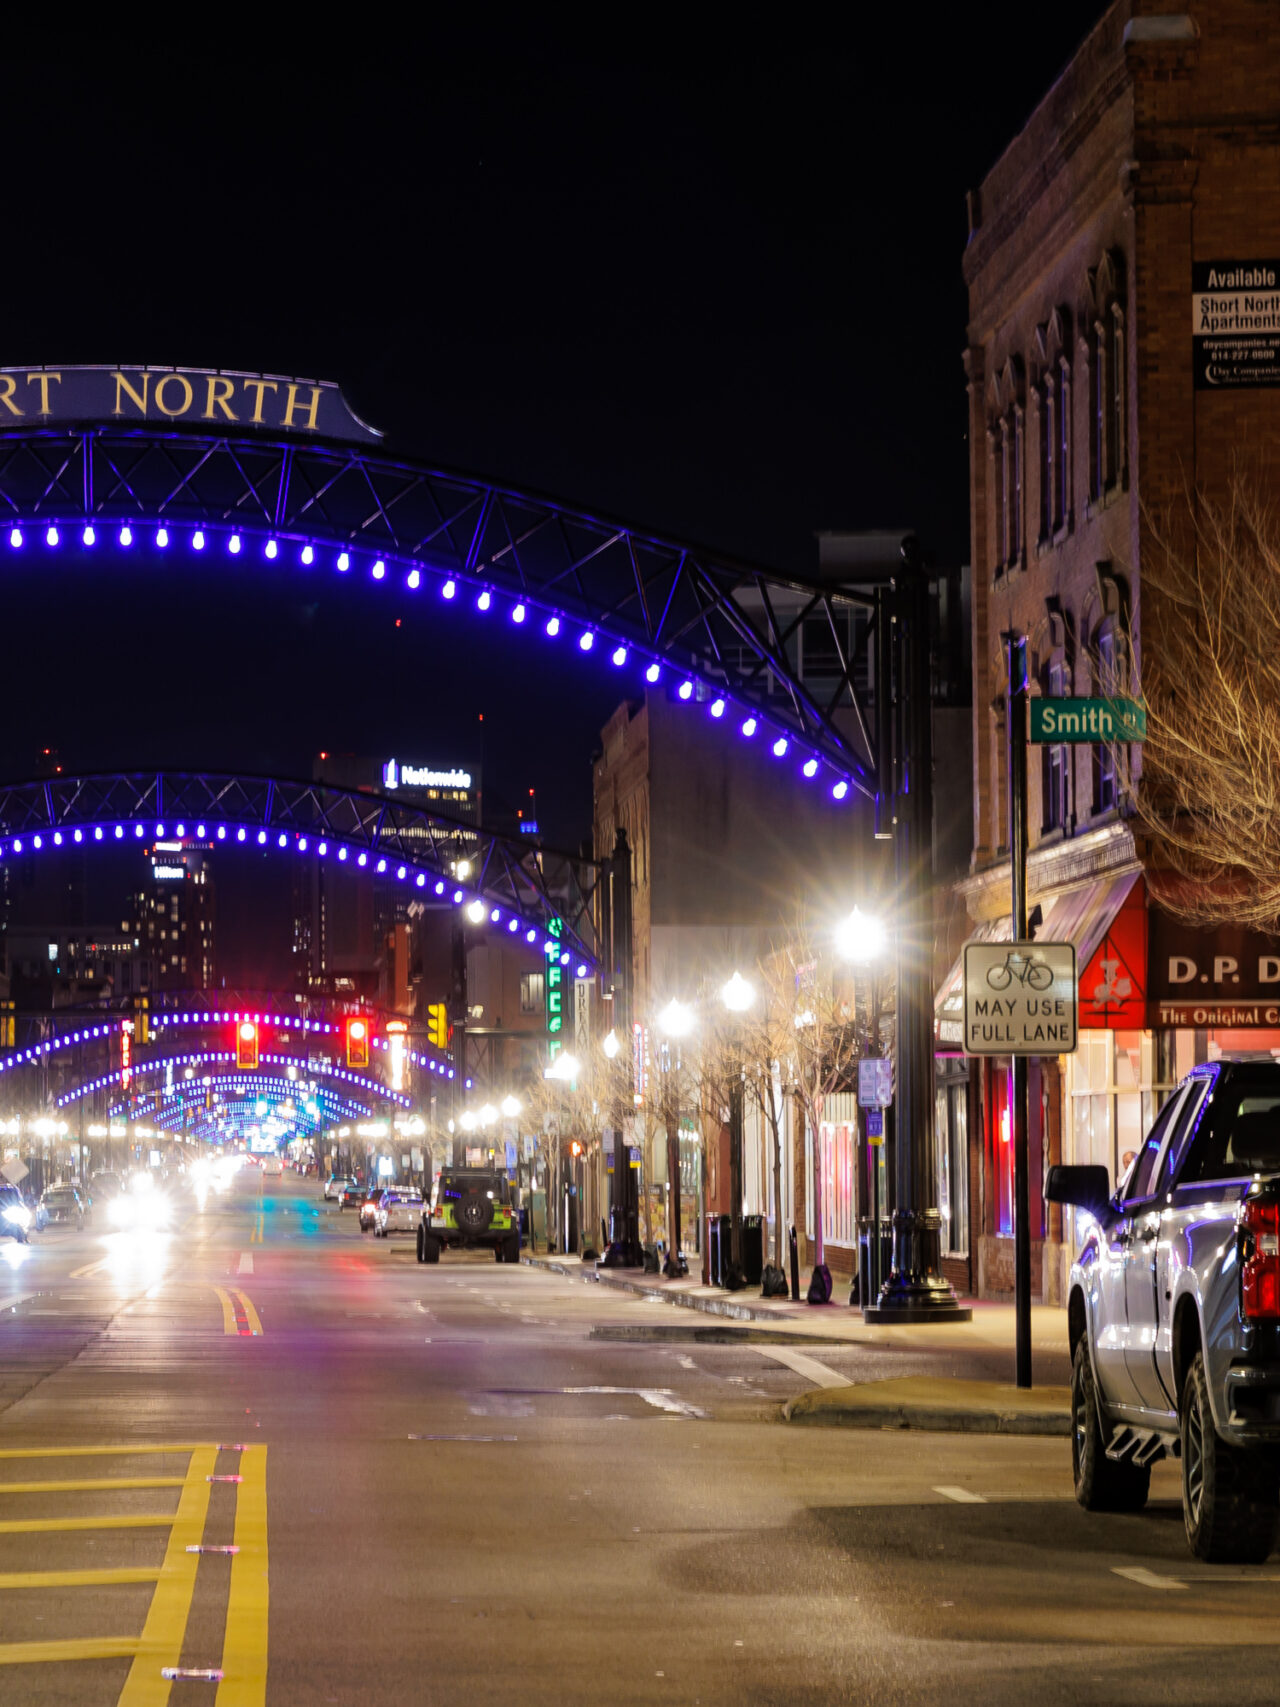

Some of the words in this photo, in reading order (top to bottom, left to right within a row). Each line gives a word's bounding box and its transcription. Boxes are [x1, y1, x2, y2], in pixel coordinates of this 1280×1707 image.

[1208, 267, 1275, 288] Available
[1201, 297, 1239, 313] Short
[110, 372, 324, 430] NORTH
[1041, 707, 1113, 733] Smith
[402, 766, 471, 788] Nationwide
[1168, 956, 1240, 983] D.P.
[975, 1000, 1017, 1016] MAY
[1027, 1000, 1065, 1016] USE
[972, 1025, 1015, 1041] FULL
[1024, 1025, 1069, 1041] LANE
